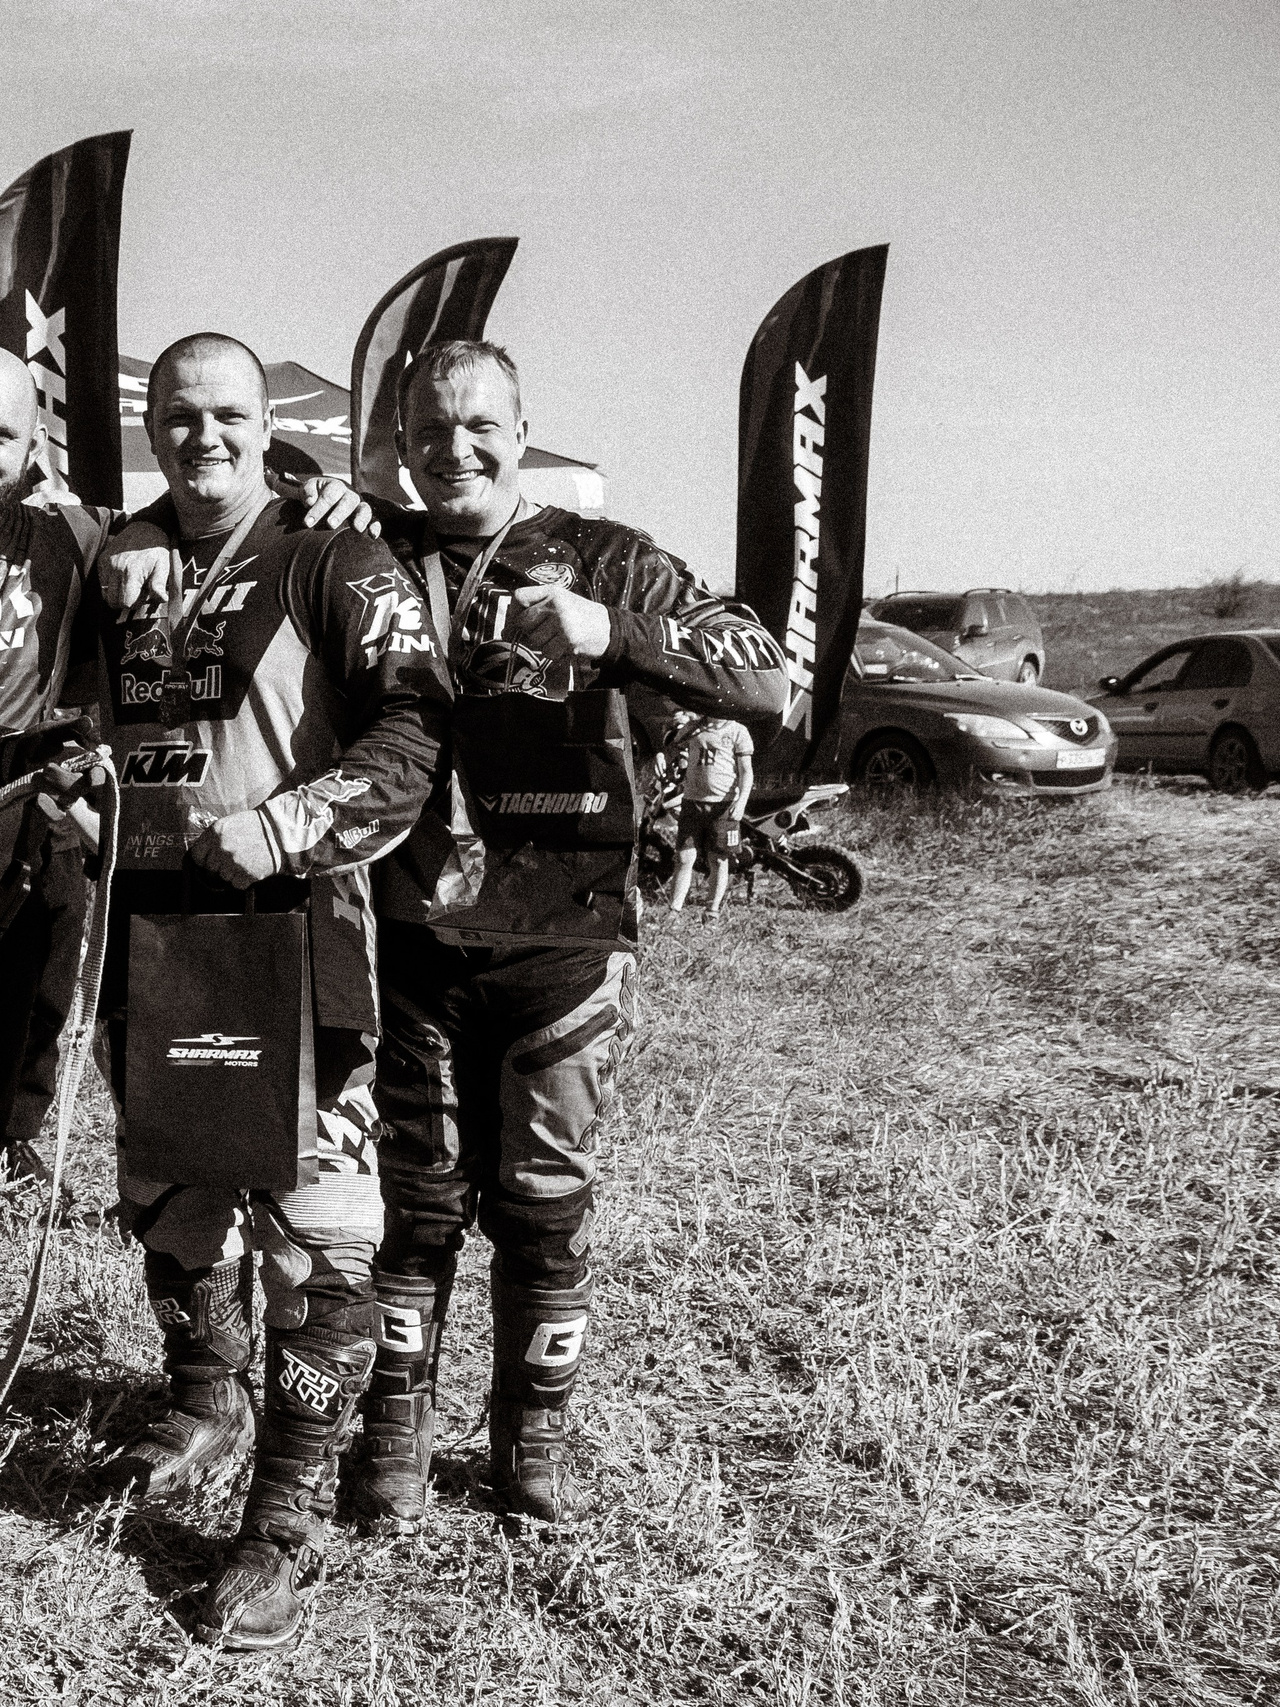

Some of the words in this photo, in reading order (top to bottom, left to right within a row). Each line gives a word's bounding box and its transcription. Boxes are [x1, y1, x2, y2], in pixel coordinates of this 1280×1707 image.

[120, 741, 213, 788] KTM
[499, 791, 609, 814] TAGENDURO
[128, 834, 176, 846] WNGS
[134, 846, 161, 859] LFE
[166, 1047, 263, 1061] SHARMAX
[223, 1060, 259, 1068] MOTORS
